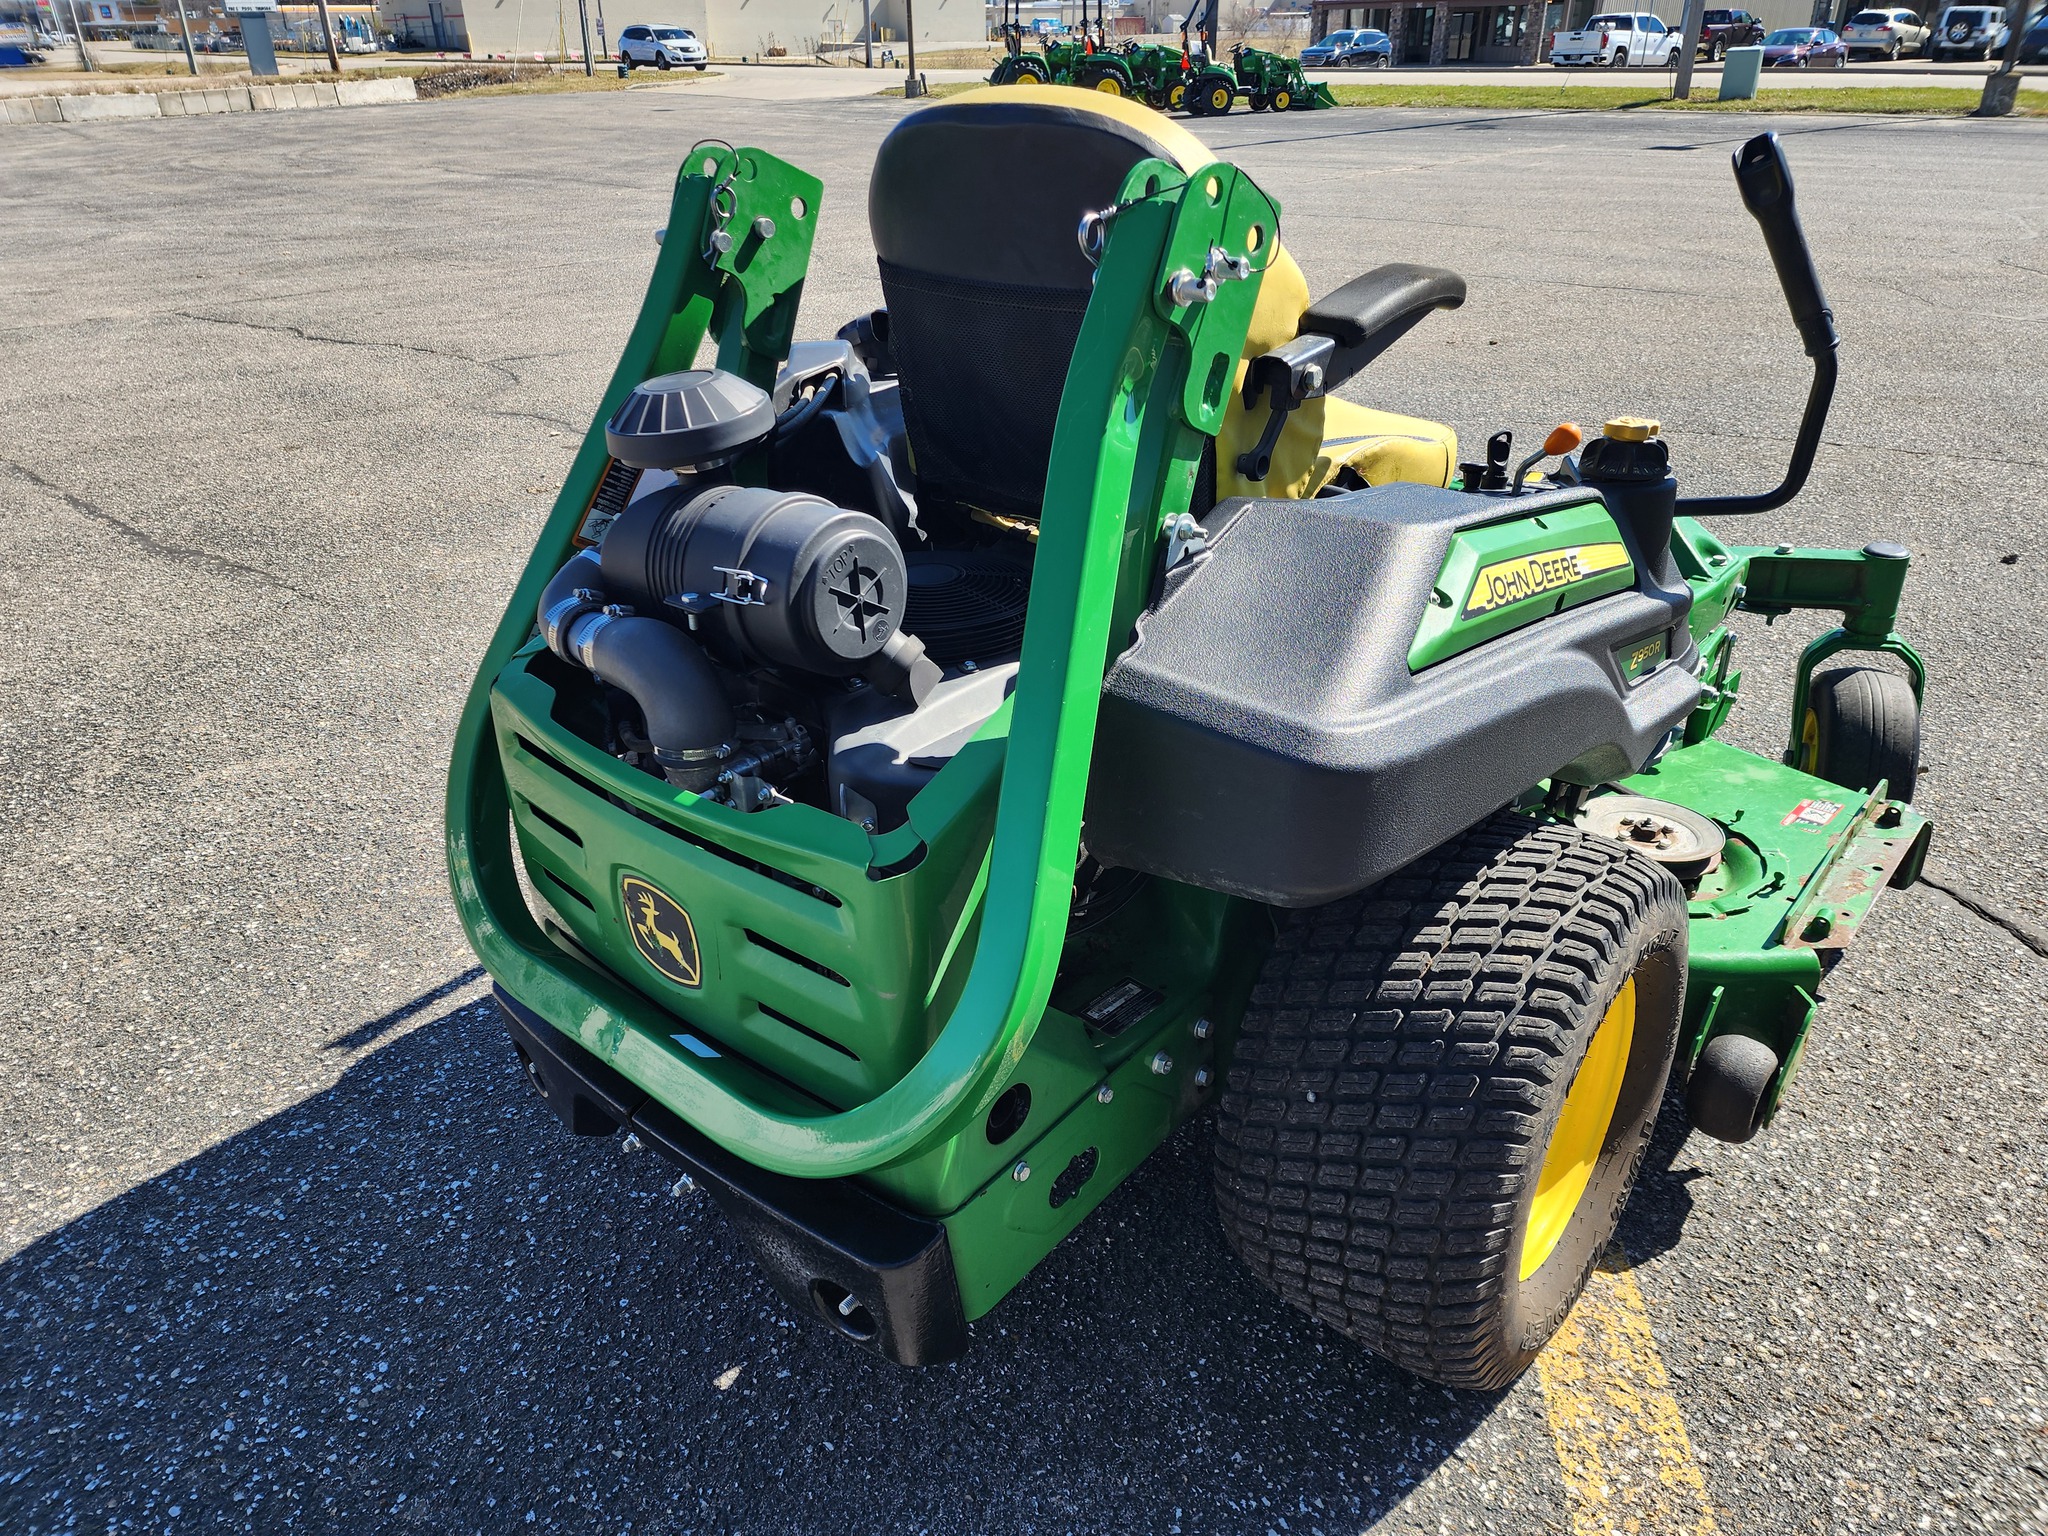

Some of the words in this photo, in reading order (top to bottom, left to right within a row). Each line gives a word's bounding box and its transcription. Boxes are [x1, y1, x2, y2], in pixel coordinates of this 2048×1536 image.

[828, 551, 848, 579] TOP
[1486, 568, 1531, 604] JOHN
[1528, 555, 1581, 587] DEERE
[1630, 640, 1661, 670] Z950R
